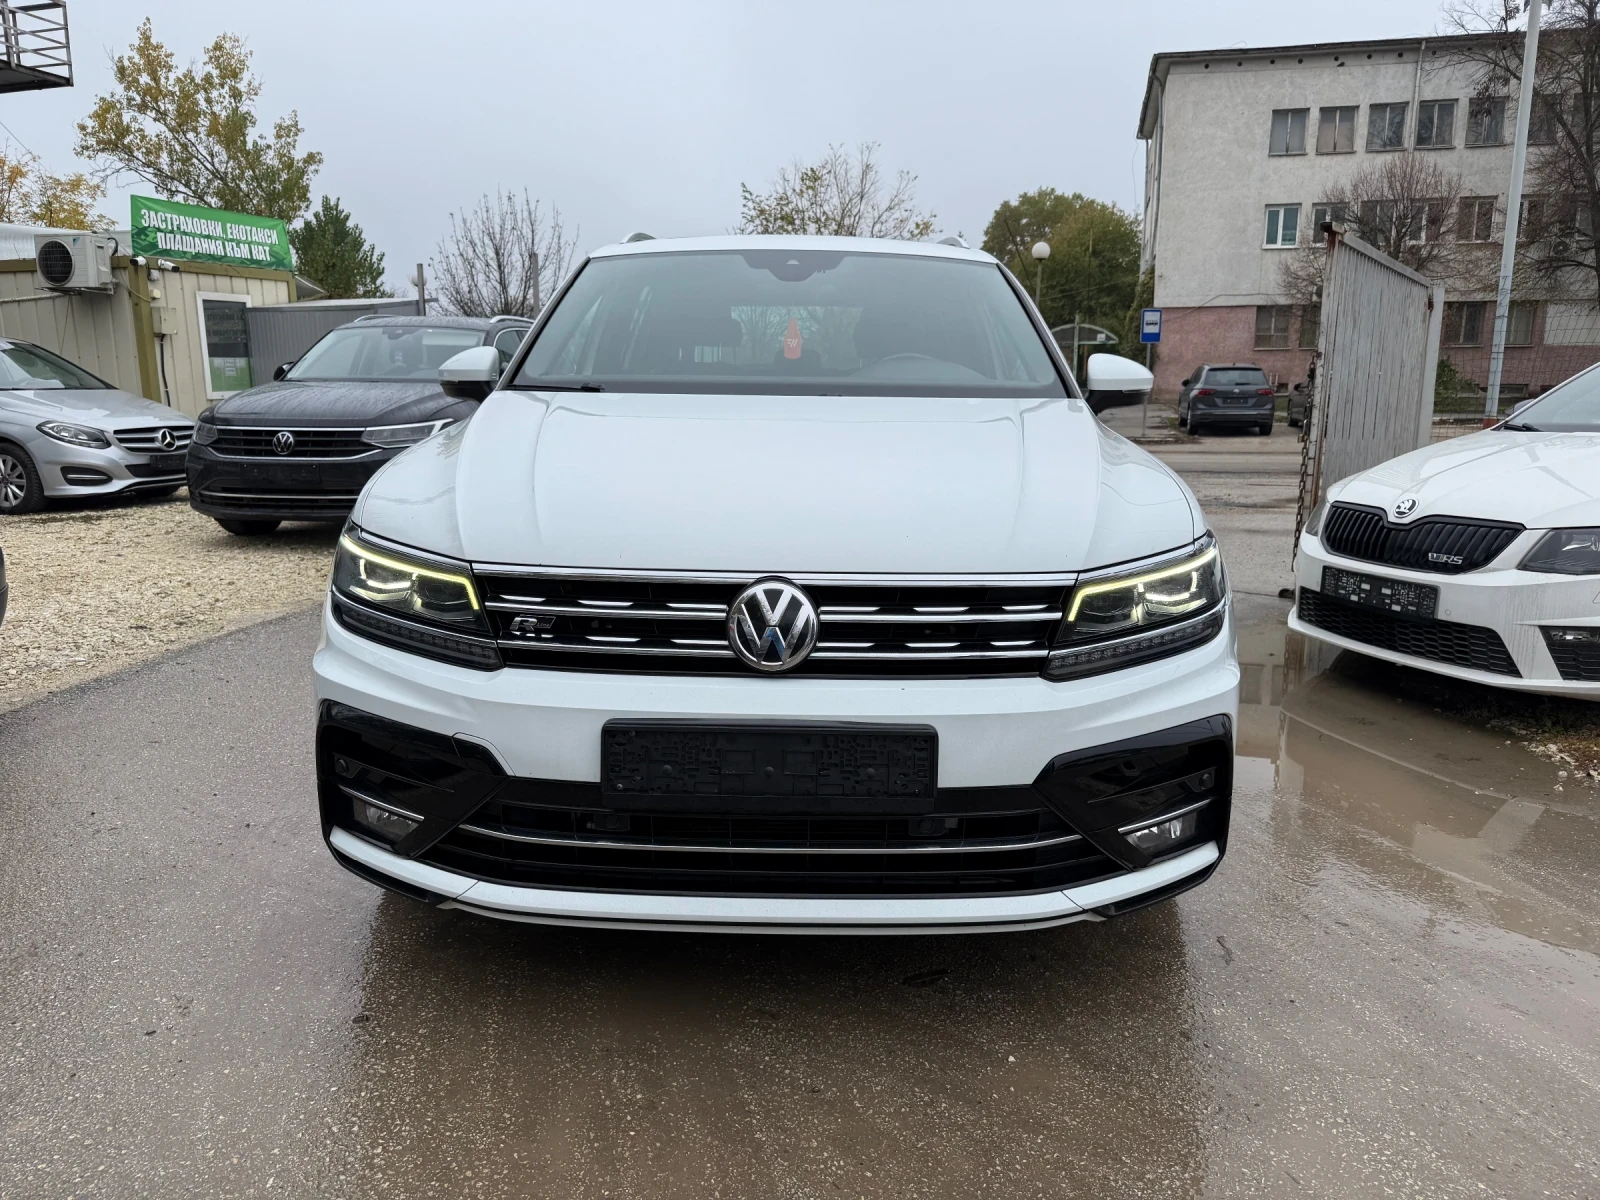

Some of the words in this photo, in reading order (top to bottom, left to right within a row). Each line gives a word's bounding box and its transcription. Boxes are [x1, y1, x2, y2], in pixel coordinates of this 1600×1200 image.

[141, 209, 225, 239] ЗАСТРАХОВКИ,
[226, 223, 278, 245] ЕКОТАКСИ
[157, 232, 225, 256] ПЛАЩАНИЯ
[225, 241, 251, 259] КЪМ
[251, 244, 270, 261] КАТ
